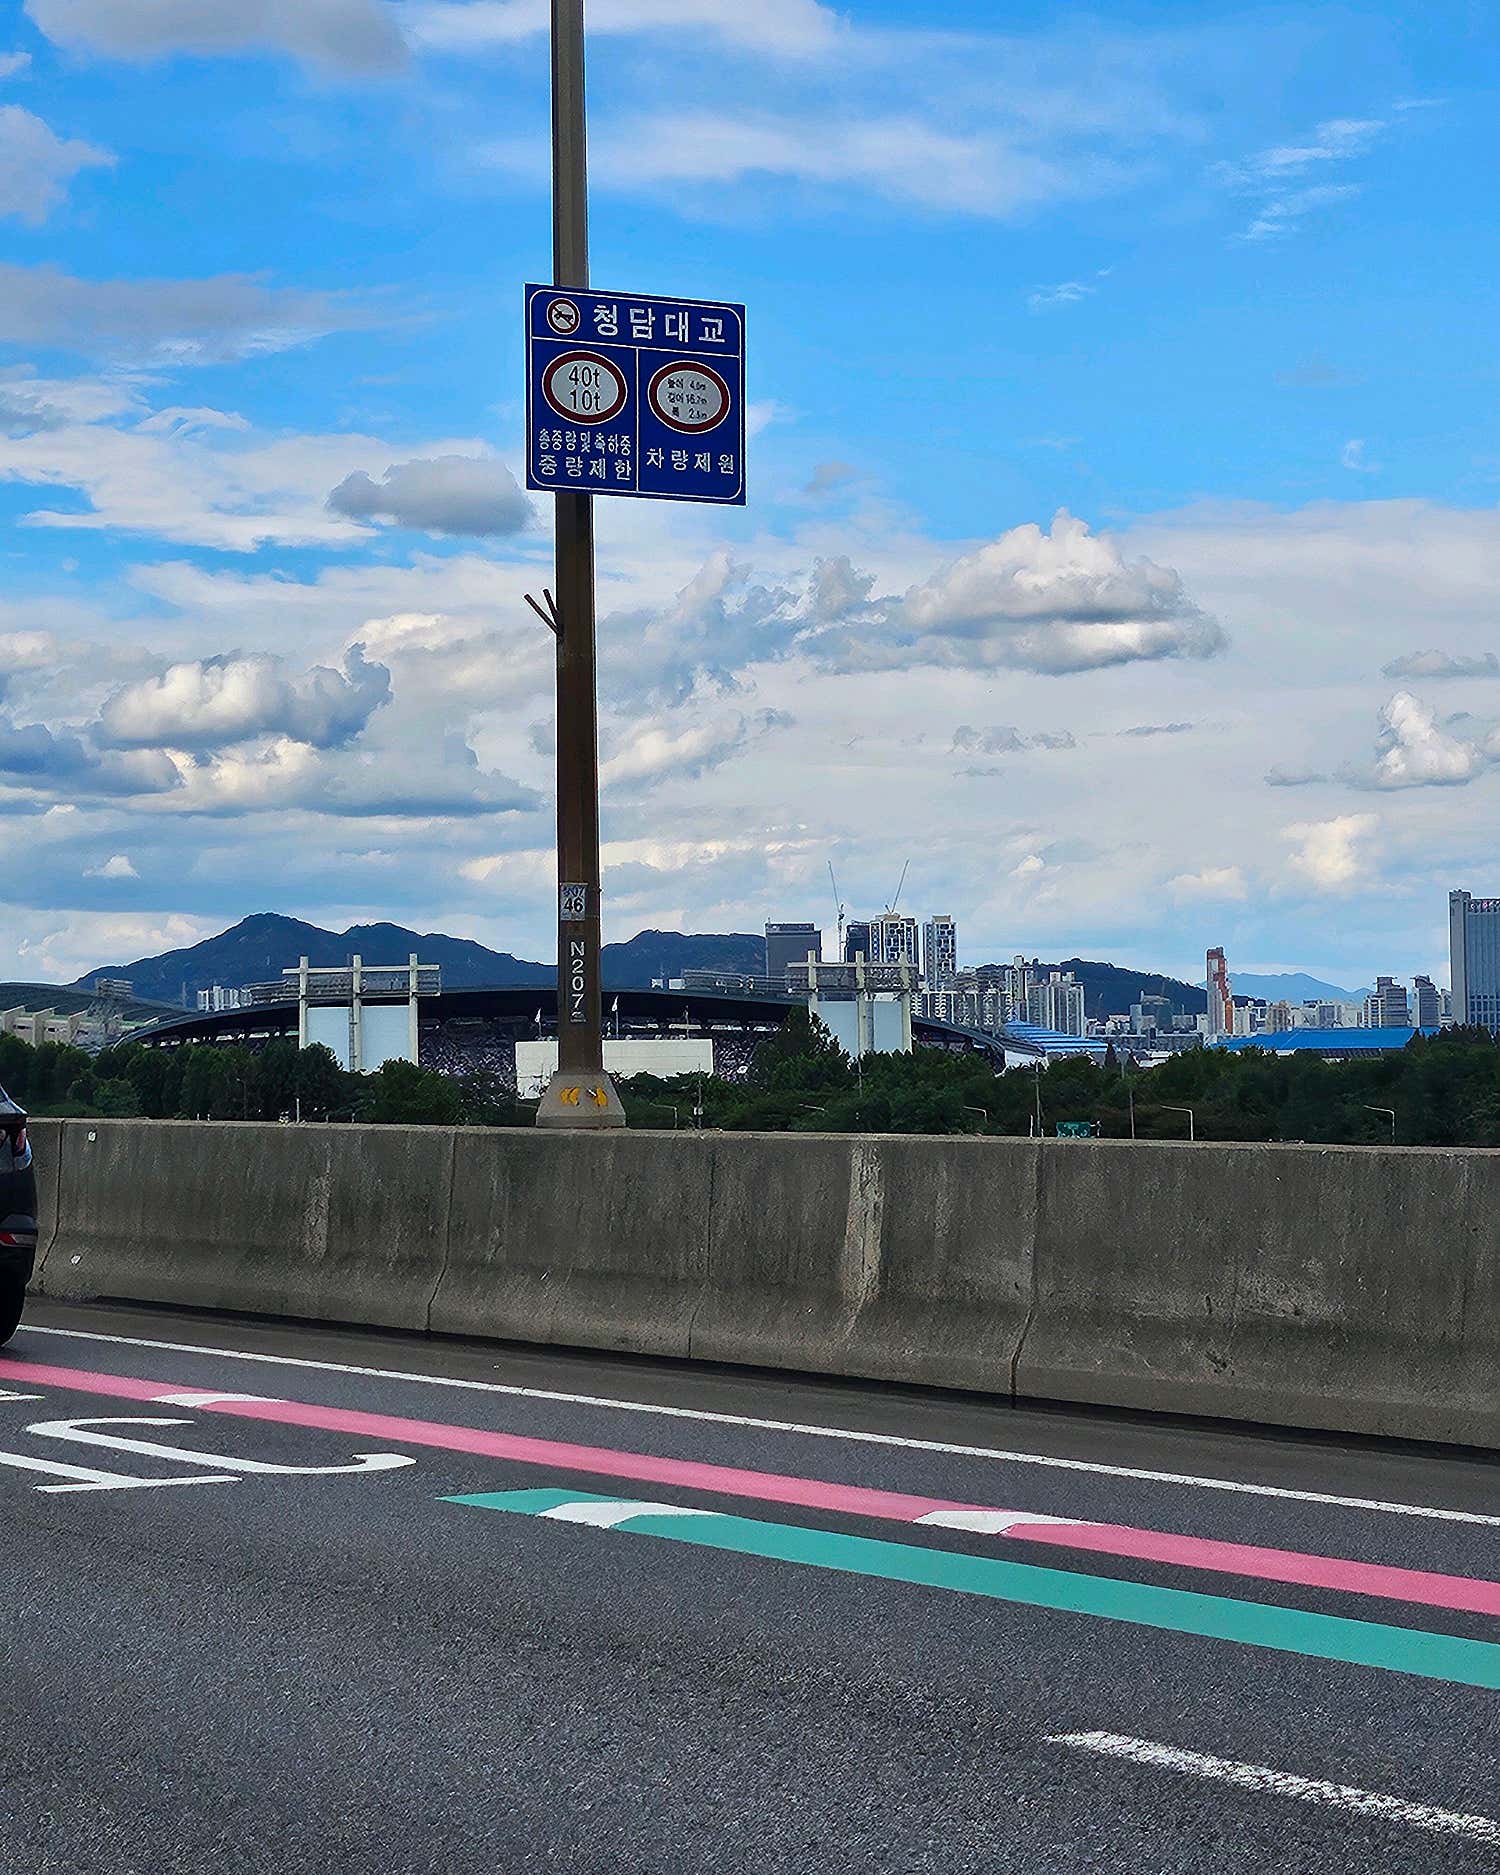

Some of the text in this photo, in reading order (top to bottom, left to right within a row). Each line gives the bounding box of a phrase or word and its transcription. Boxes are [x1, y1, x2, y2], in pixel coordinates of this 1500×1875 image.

[593, 304, 726, 343] 청담대교
[568, 366, 601, 389] 40t
[568, 389, 601, 412] 10t
[538, 453, 632, 481] 중량제한
[646, 447, 735, 475] 차량제원
[563, 896, 584, 912] 46
